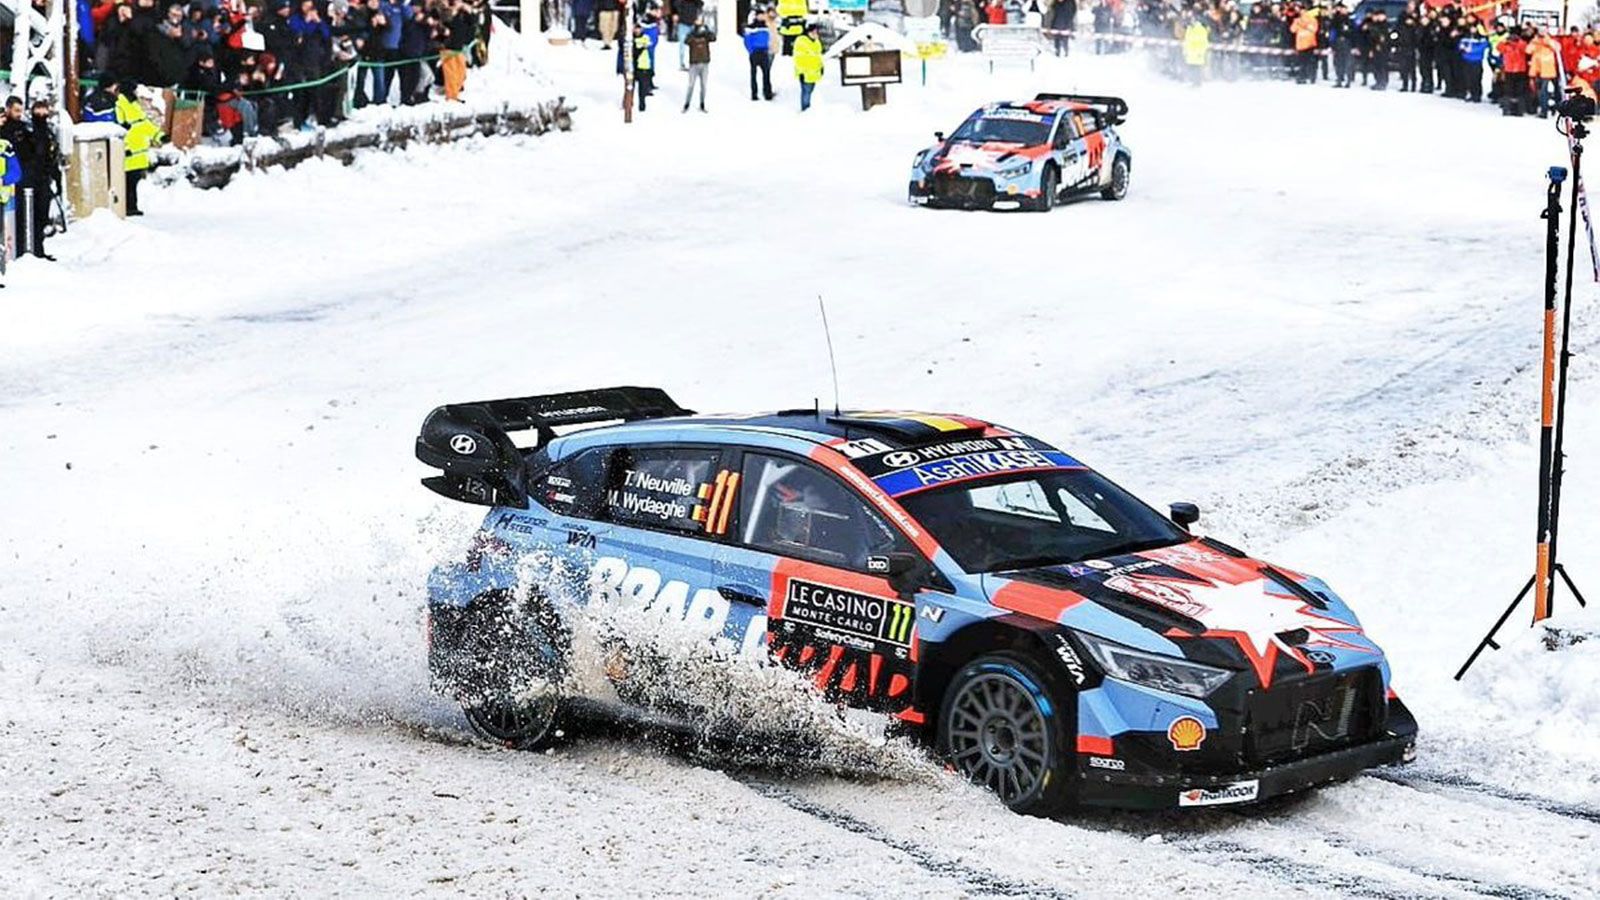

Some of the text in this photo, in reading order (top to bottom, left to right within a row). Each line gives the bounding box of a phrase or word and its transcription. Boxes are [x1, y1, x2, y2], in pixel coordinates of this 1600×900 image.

[919, 439, 997, 460] HYUNDAI
[624, 469, 692, 496] T. Neuville
[623, 491, 686, 520] Wydaeghe
[705, 469, 740, 534] 11
[791, 583, 882, 620] LE CASINO
[792, 605, 874, 633] MONTE-CARLO
[888, 603, 911, 642] 11
[814, 627, 876, 650] SafetyCulture
[1090, 756, 1125, 771] sparco
